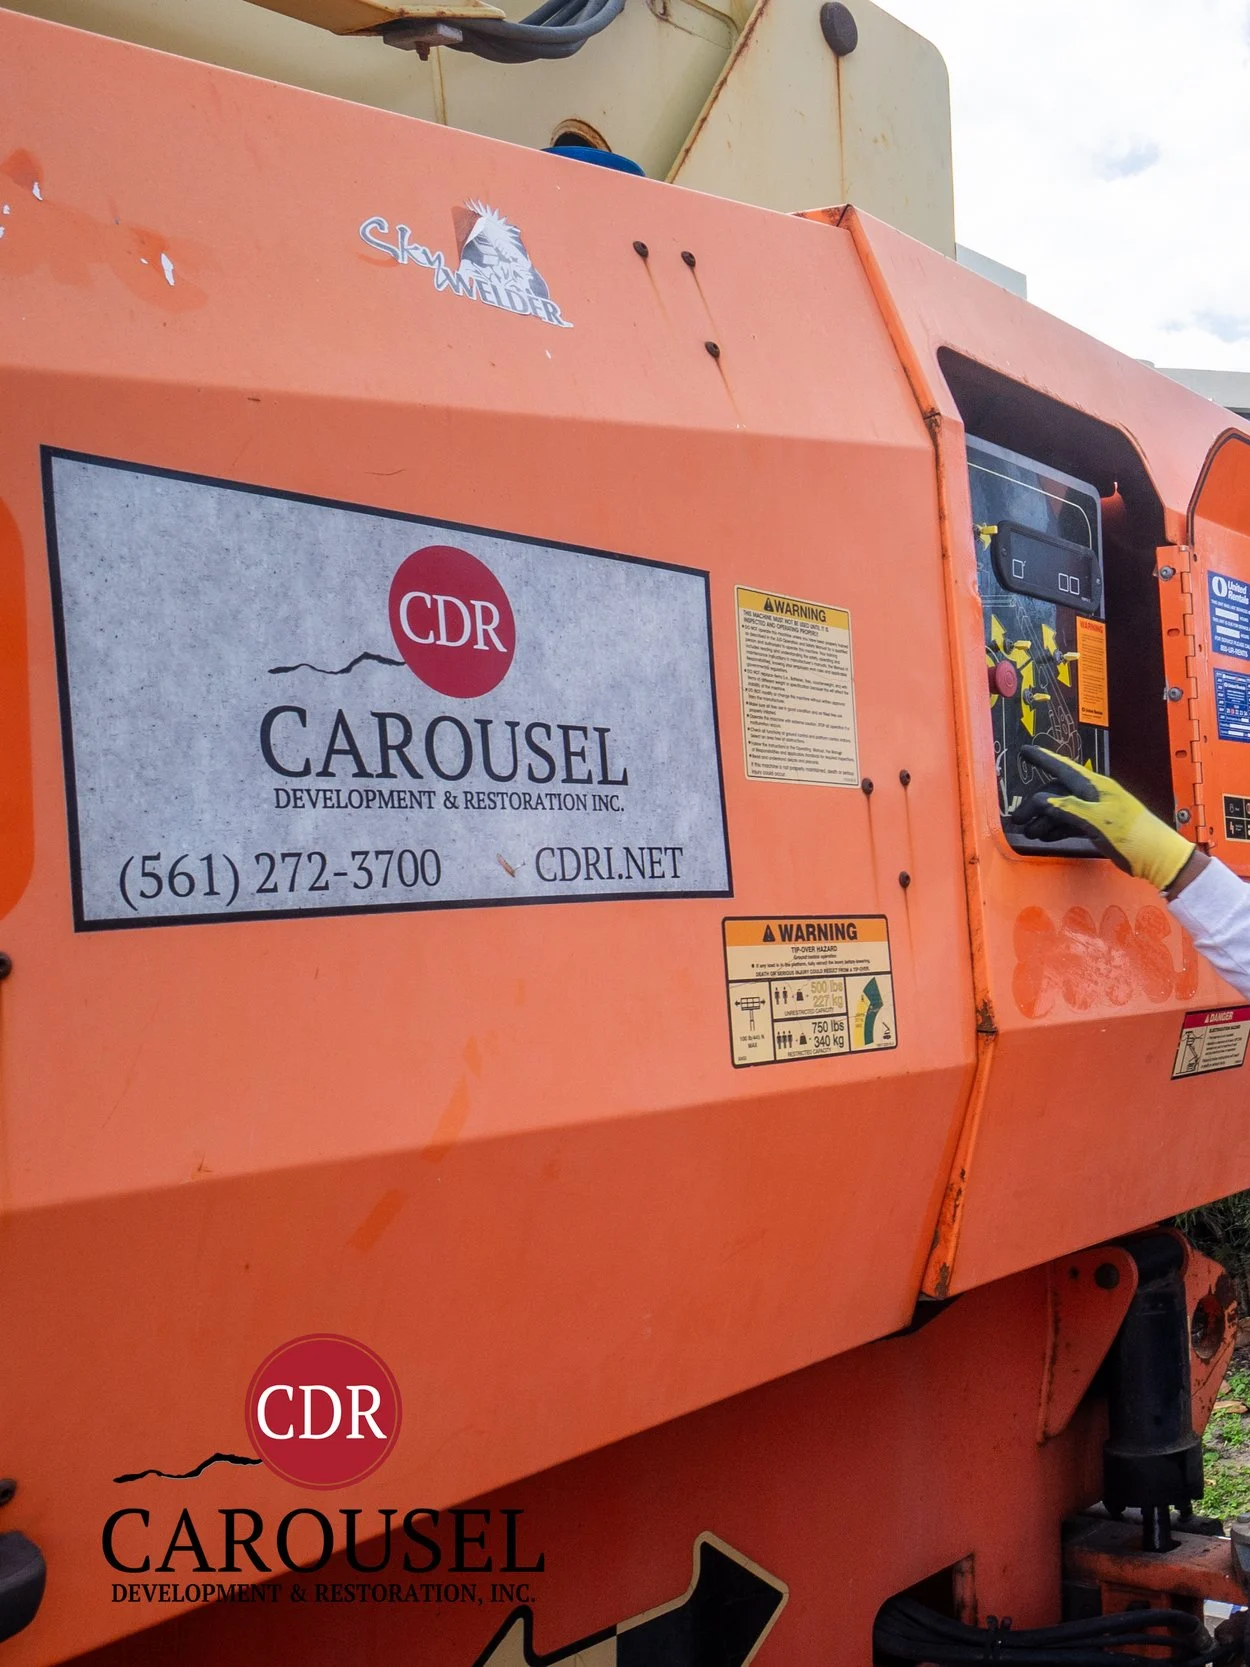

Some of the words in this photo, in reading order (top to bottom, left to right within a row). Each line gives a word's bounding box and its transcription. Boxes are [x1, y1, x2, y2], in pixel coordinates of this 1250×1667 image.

[445, 266, 573, 327] WELDER
[1228, 580, 1248, 594] United
[1228, 590, 1249, 604] Rentals
[774, 599, 827, 622] WARNING
[400, 591, 507, 652] CDR
[1080, 620, 1103, 634] WARNING
[260, 705, 628, 785] CAROUSEL
[274, 788, 436, 810] DEVELOPMENT
[444, 791, 459, 810] &
[463, 792, 588, 812] RESTORATION
[592, 795, 624, 812] INC.
[118, 853, 241, 910] (561)
[254, 848, 442, 895] 272-3700
[534, 846, 683, 882] CDRI.NET
[778, 923, 857, 941] WARNING
[811, 981, 827, 994] 500
[830, 980, 843, 992] lbs
[813, 994, 830, 1007] 227
[832, 994, 843, 1008] kg
[1210, 1012, 1234, 1022] DANGER
[812, 1021, 828, 1034] 750
[831, 1020, 844, 1032] lbs
[814, 1035, 830, 1048] 340
[833, 1034, 844, 1048] kg
